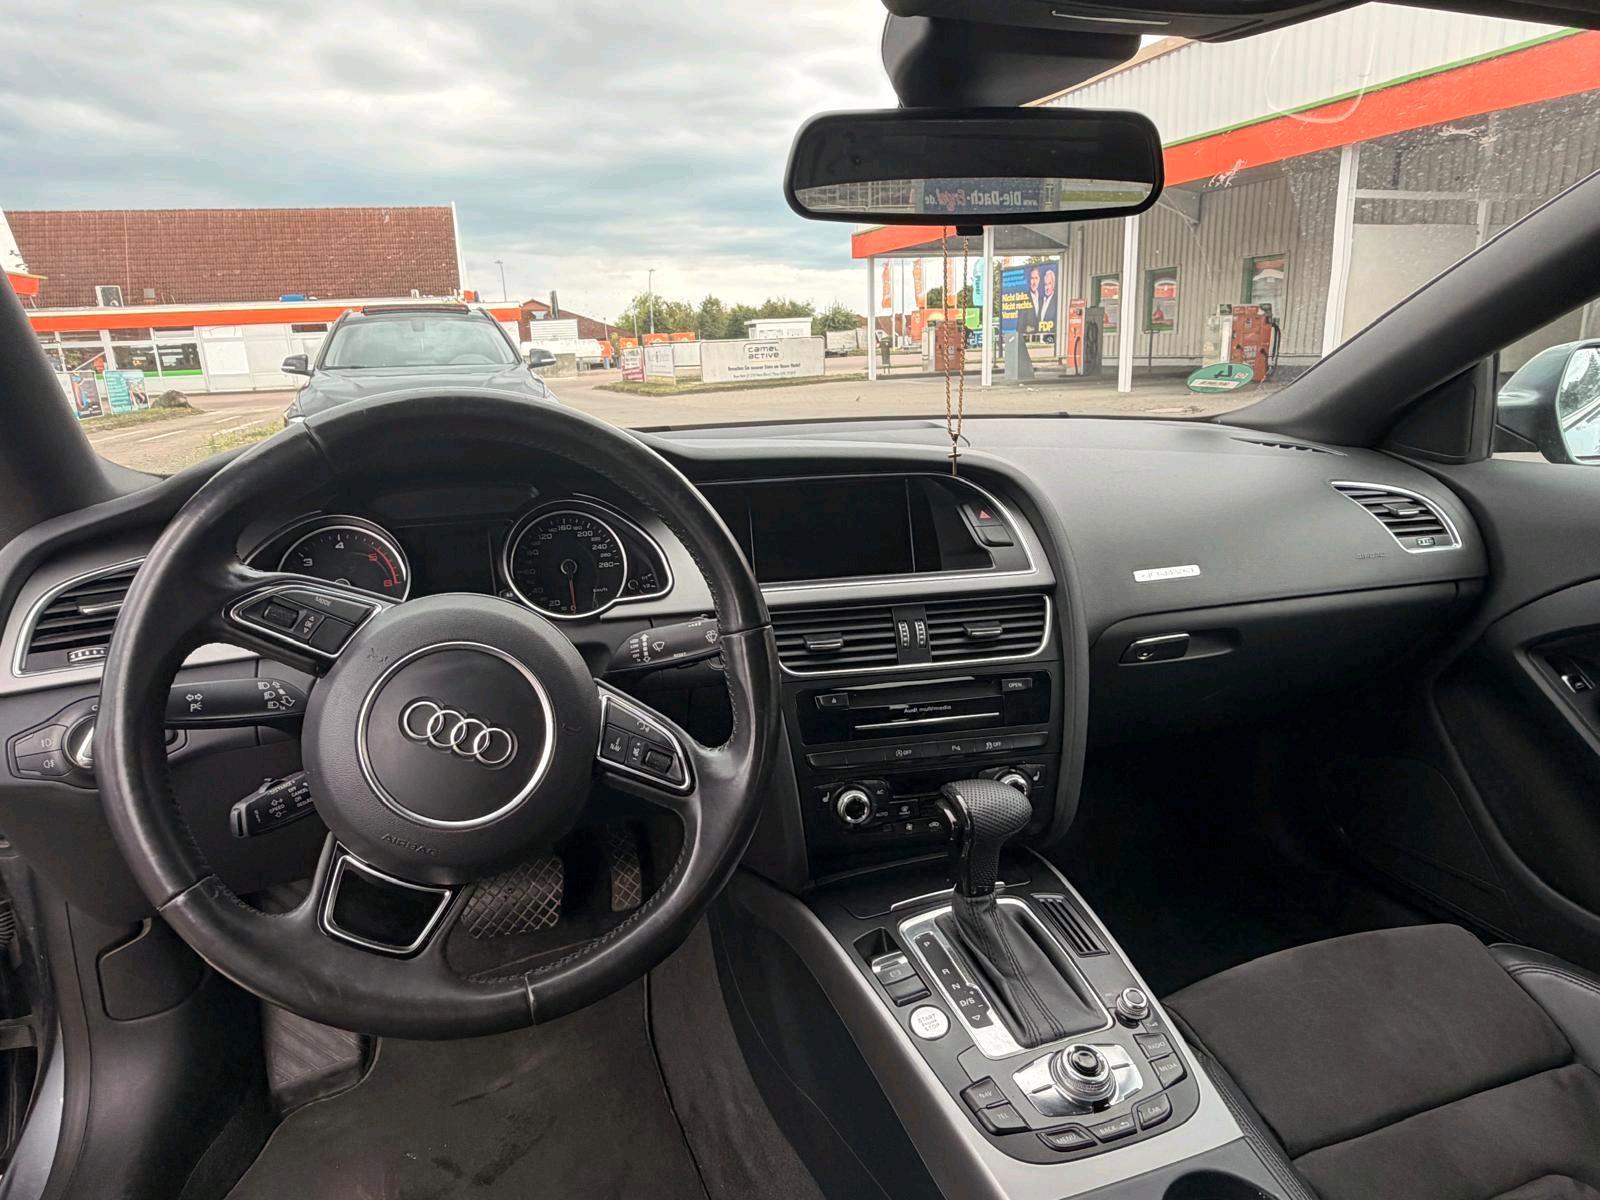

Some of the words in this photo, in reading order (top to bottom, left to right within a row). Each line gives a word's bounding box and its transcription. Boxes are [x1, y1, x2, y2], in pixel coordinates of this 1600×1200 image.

[1039, 321, 1054, 332] FDP
[304, 558, 313, 566] 3
[368, 553, 378, 562] 5
[960, 997, 976, 1007] D/S
[918, 1013, 936, 1021] START
[924, 1023, 940, 1031] STOP
[1056, 1134, 1078, 1144] MENU
